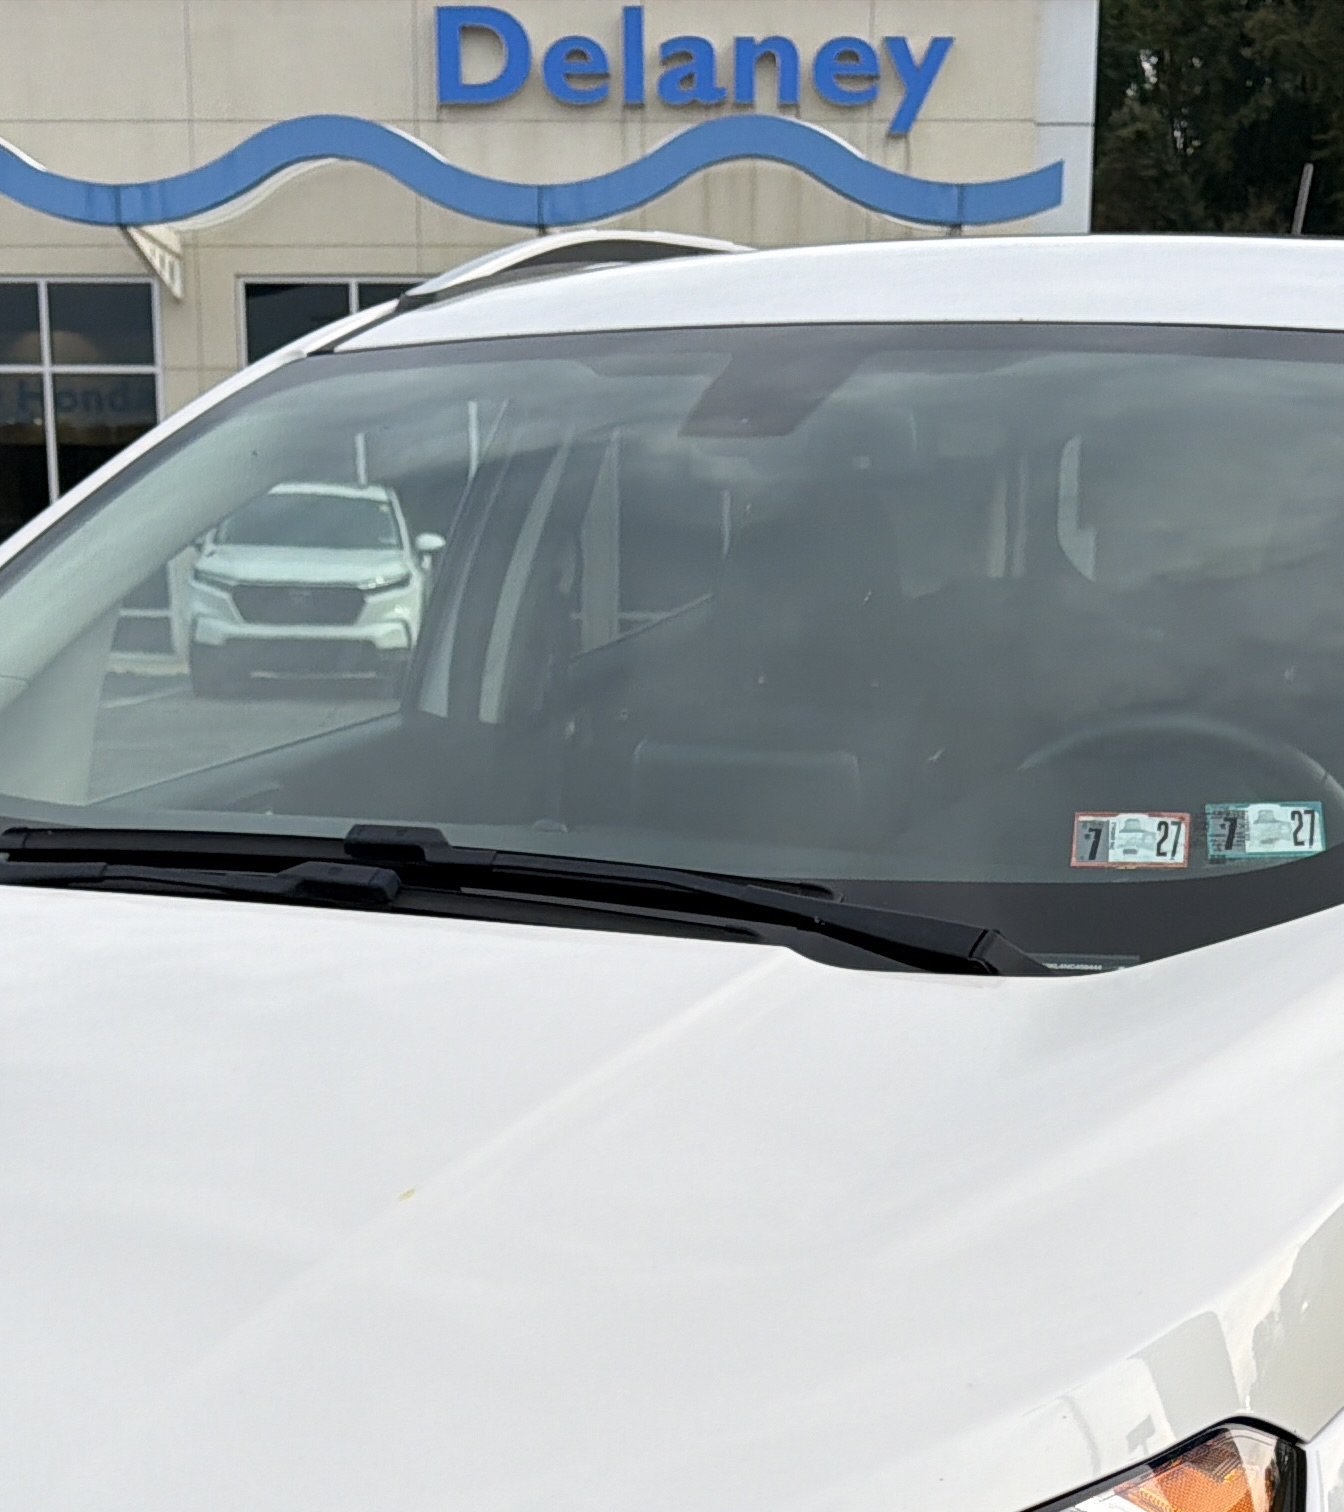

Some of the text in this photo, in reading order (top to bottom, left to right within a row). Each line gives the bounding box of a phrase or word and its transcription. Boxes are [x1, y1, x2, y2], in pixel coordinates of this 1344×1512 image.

[436, 5, 954, 137] Delaney
[1088, 827, 1103, 861] 7
[1156, 820, 1183, 857] 27
[1223, 817, 1238, 851] 7
[1291, 809, 1316, 847] 27
